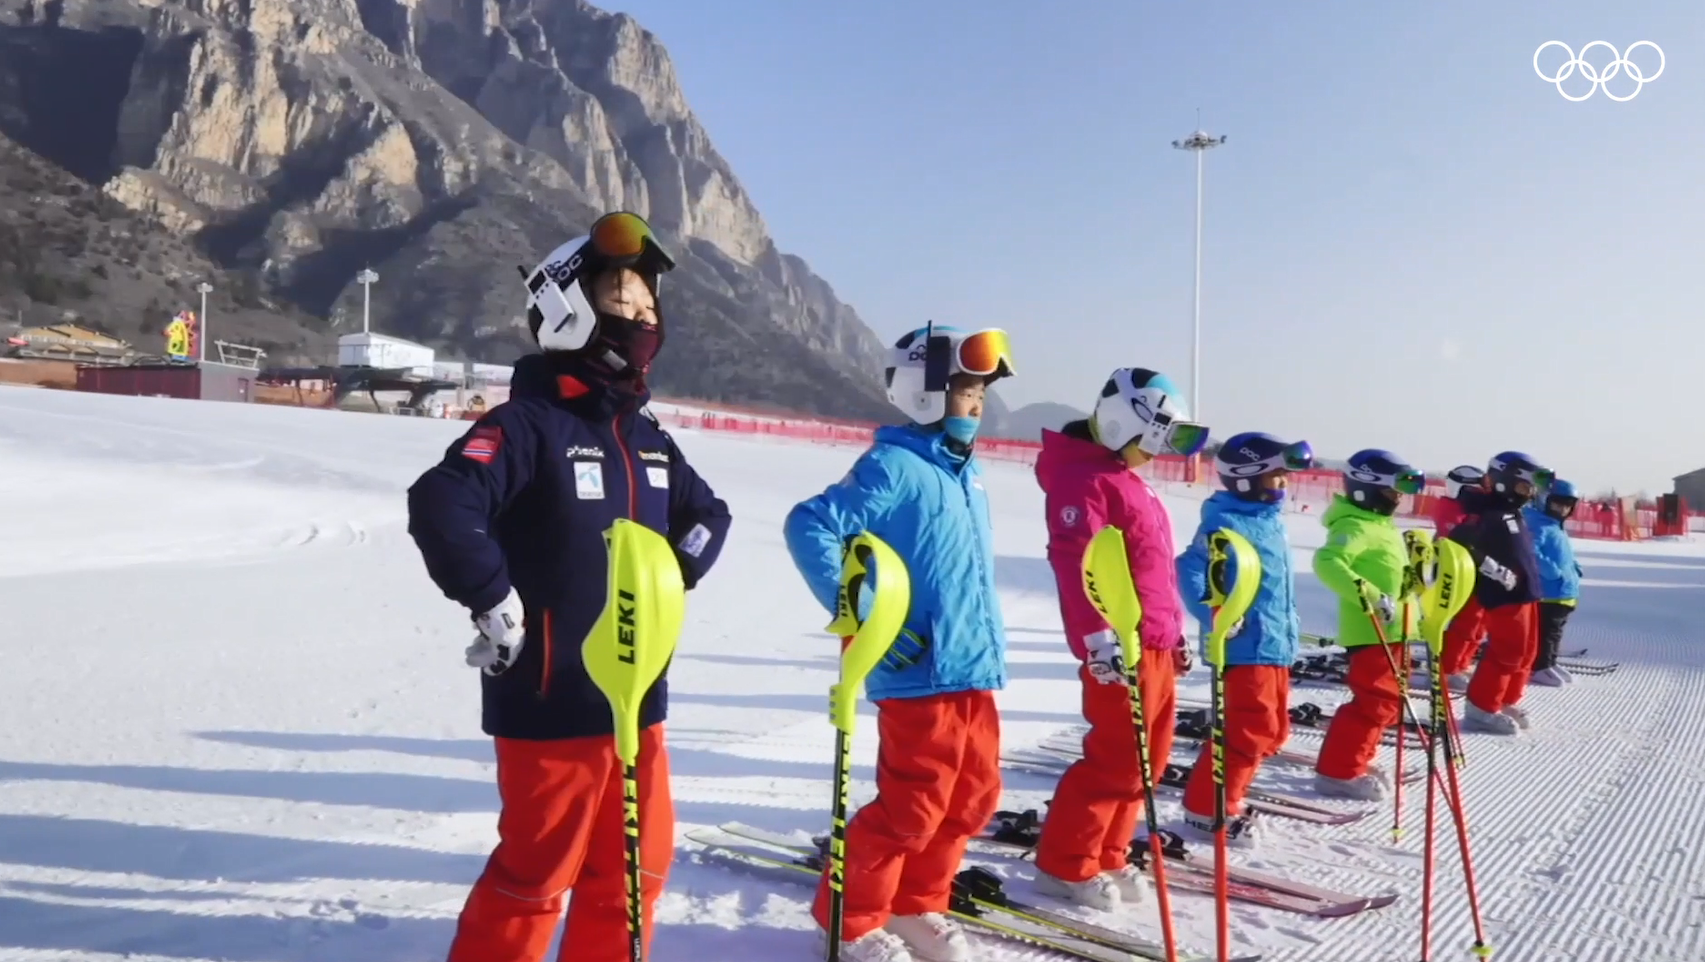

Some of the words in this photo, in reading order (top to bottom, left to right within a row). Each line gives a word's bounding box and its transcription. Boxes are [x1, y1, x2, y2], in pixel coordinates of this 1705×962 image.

[1085, 570, 1108, 614] LEKI
[1439, 573, 1452, 609] LEKI
[618, 589, 635, 665] LEKI
[1211, 727, 1223, 784] LEKI
[622, 760, 639, 837] LEKI
[829, 817, 845, 893] LEKI
